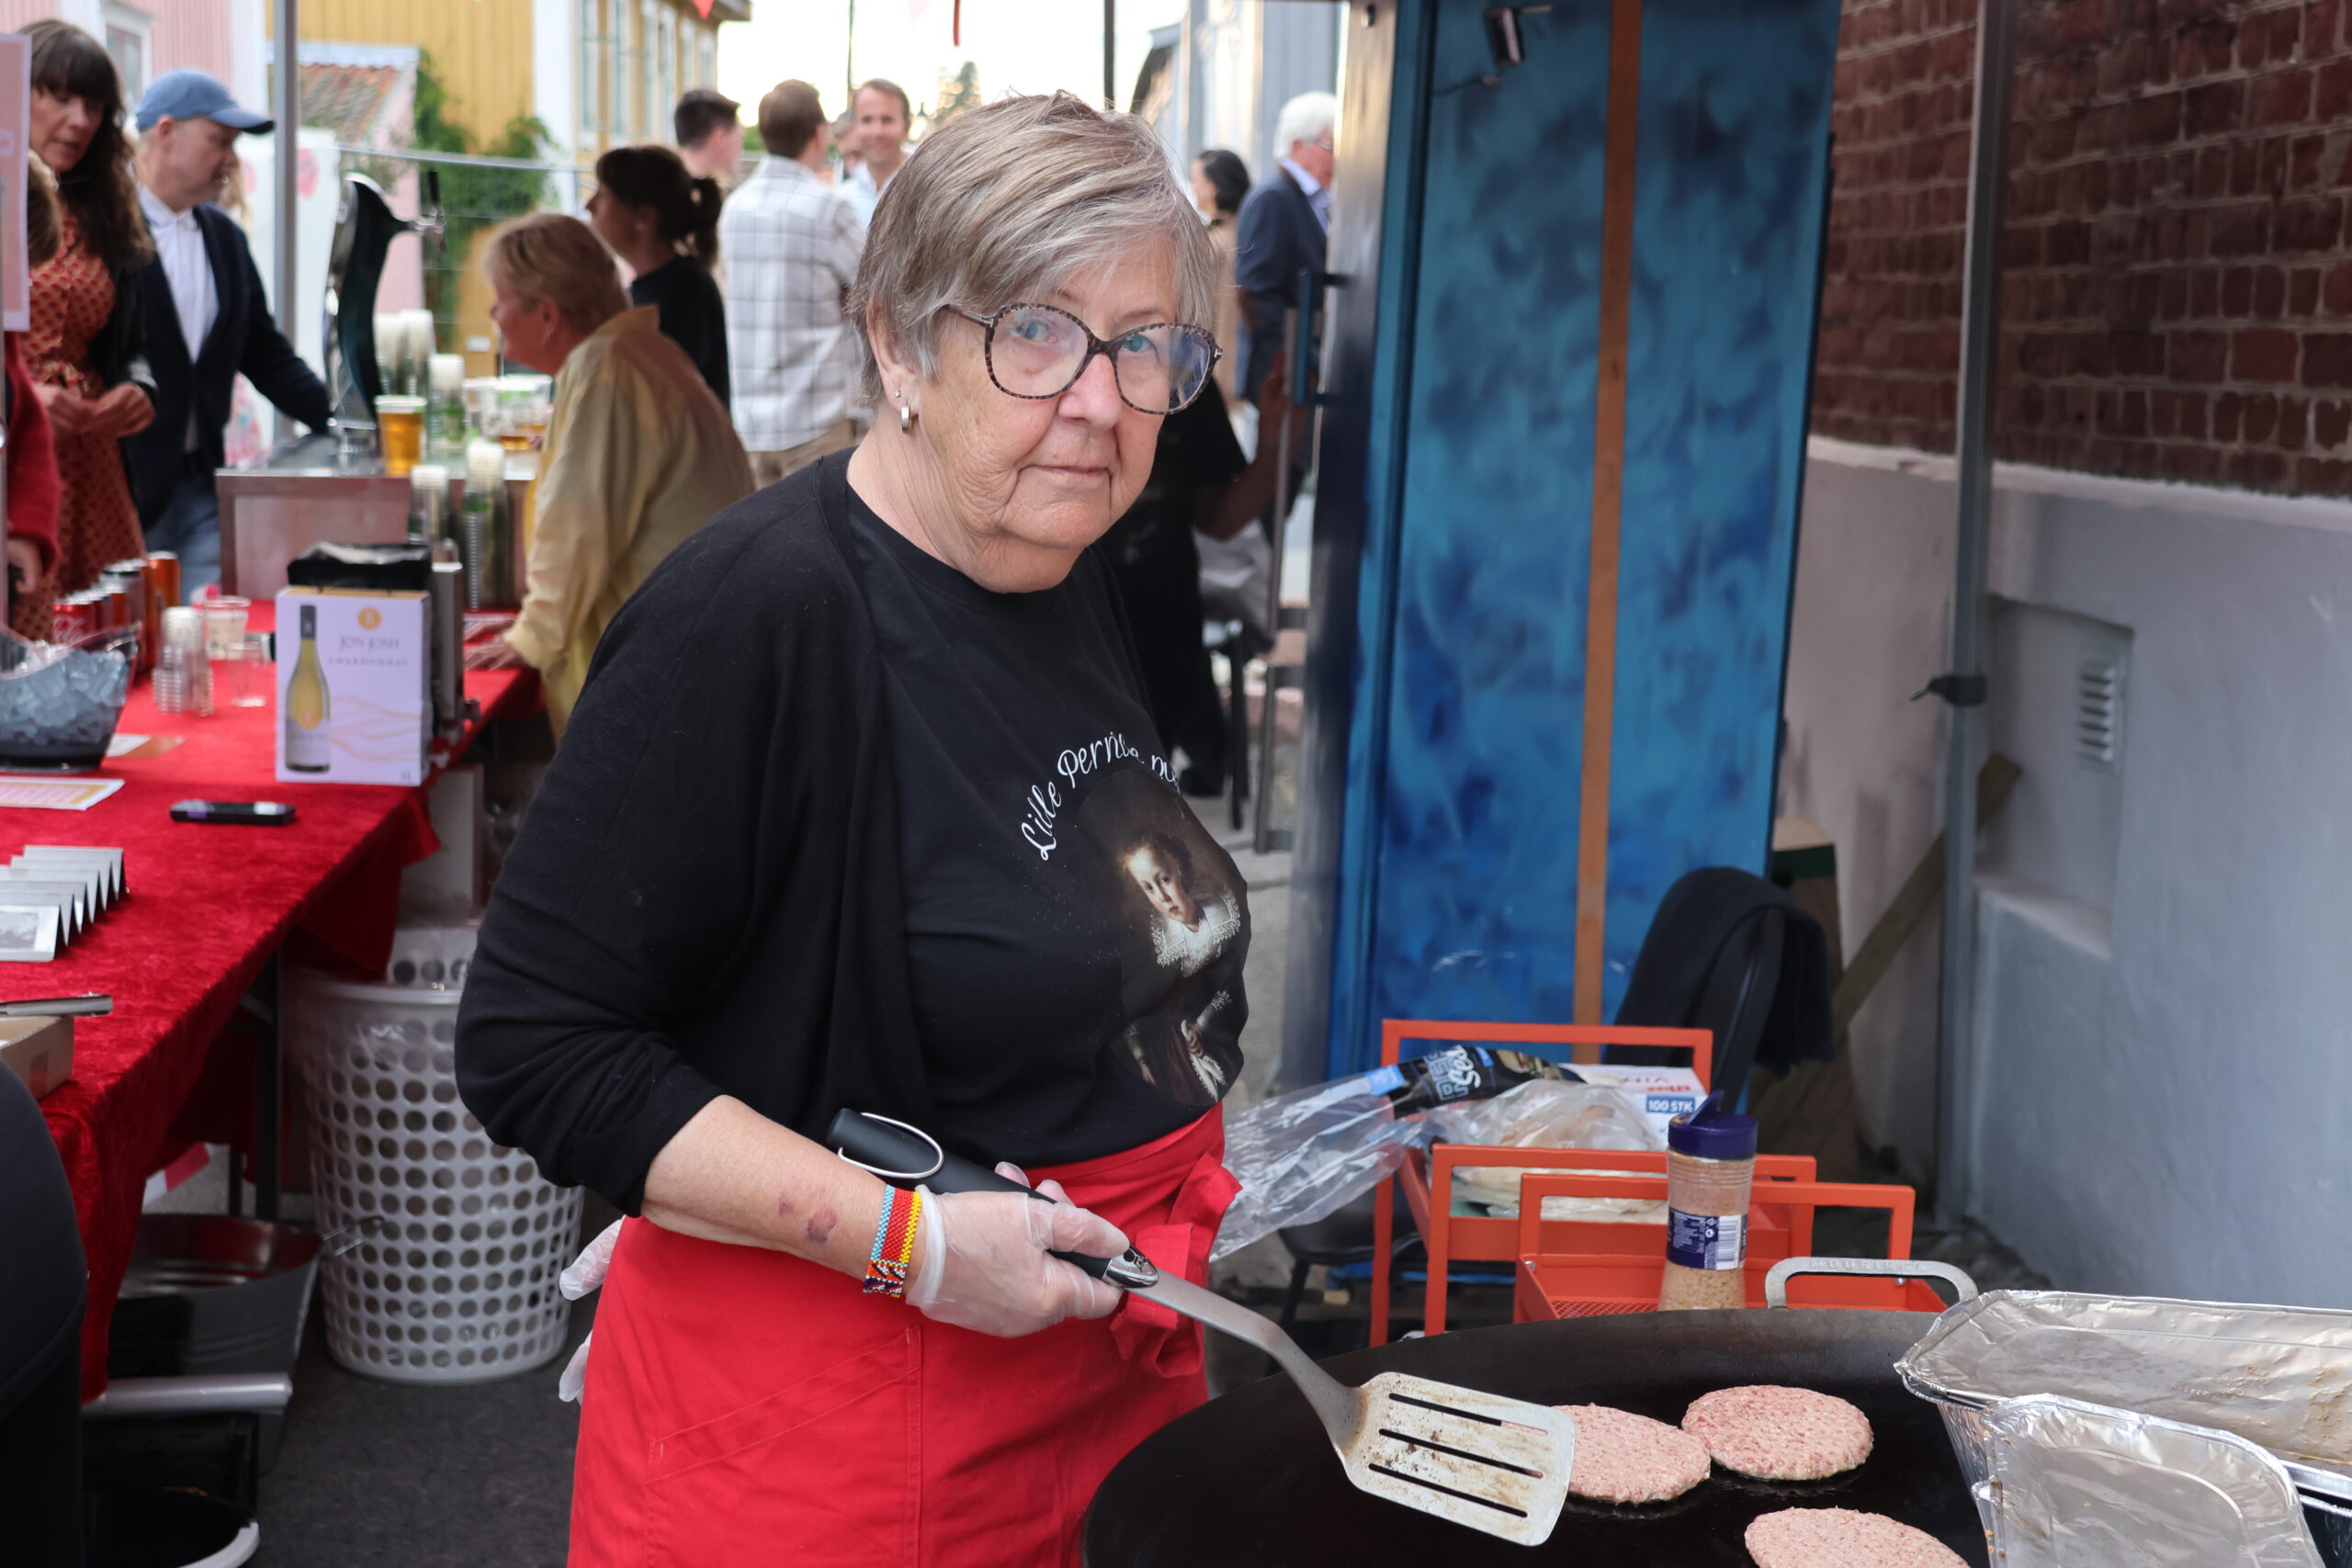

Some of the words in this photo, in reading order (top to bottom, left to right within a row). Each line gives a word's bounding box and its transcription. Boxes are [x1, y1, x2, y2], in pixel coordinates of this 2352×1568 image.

[1021, 781, 1062, 861] Lille
[1648, 1100, 1669, 1111] 100
[1670, 1100, 1693, 1112] STK
